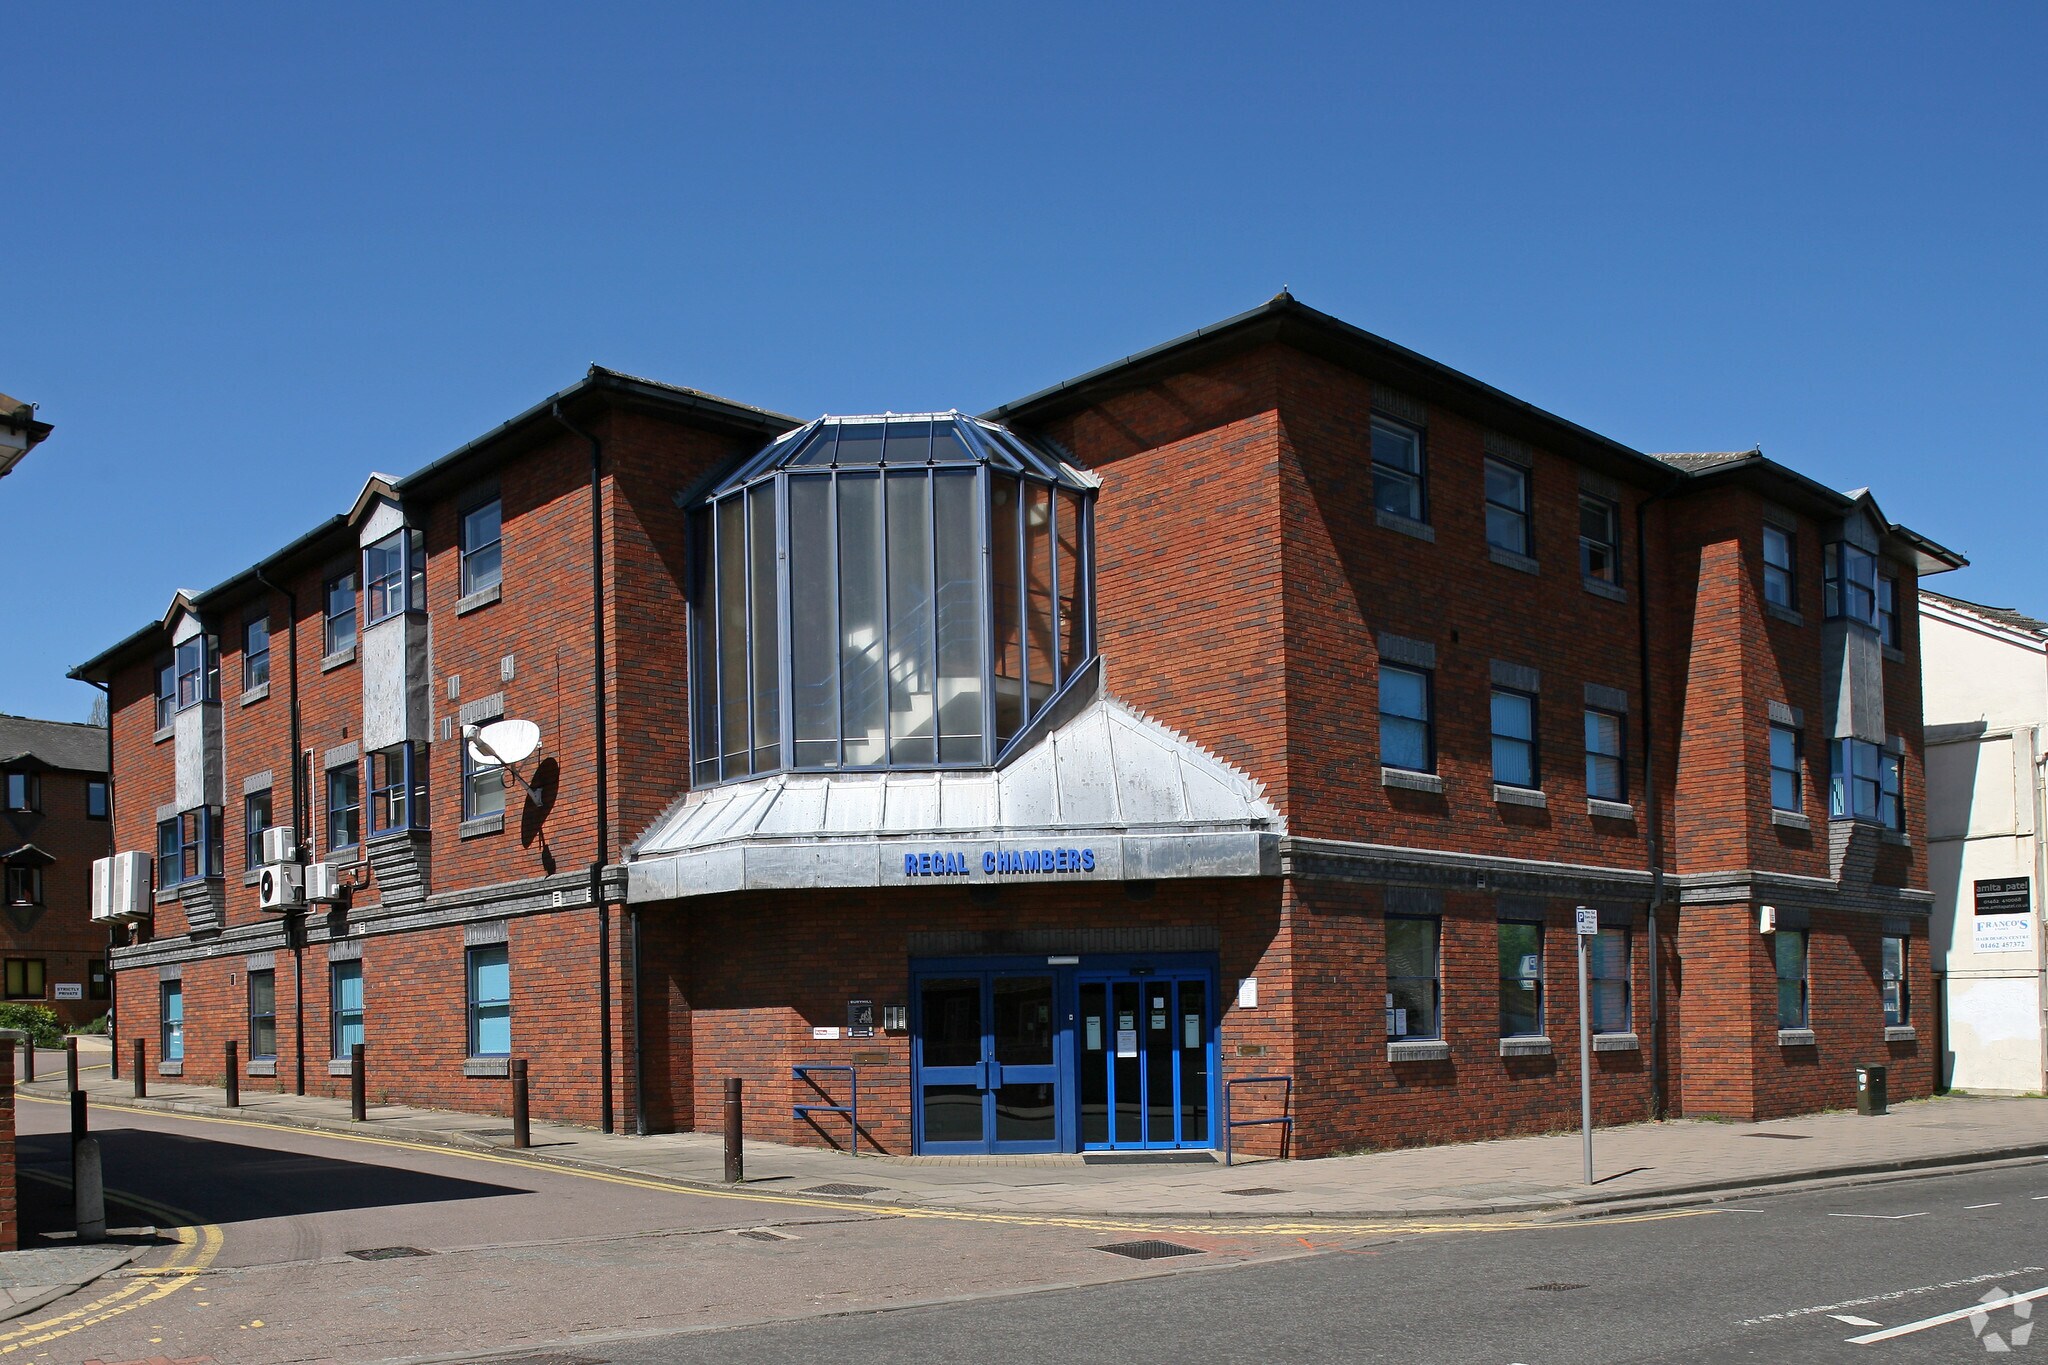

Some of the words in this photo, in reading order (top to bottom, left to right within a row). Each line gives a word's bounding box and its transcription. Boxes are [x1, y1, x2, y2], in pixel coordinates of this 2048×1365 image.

[905, 852, 969, 876] REGAL
[982, 848, 1095, 875] CHAMBERS
[2005, 881, 2027, 892] patel
[1977, 919, 2028, 932] FRANCO'S
[2002, 940, 2025, 948] 457372
